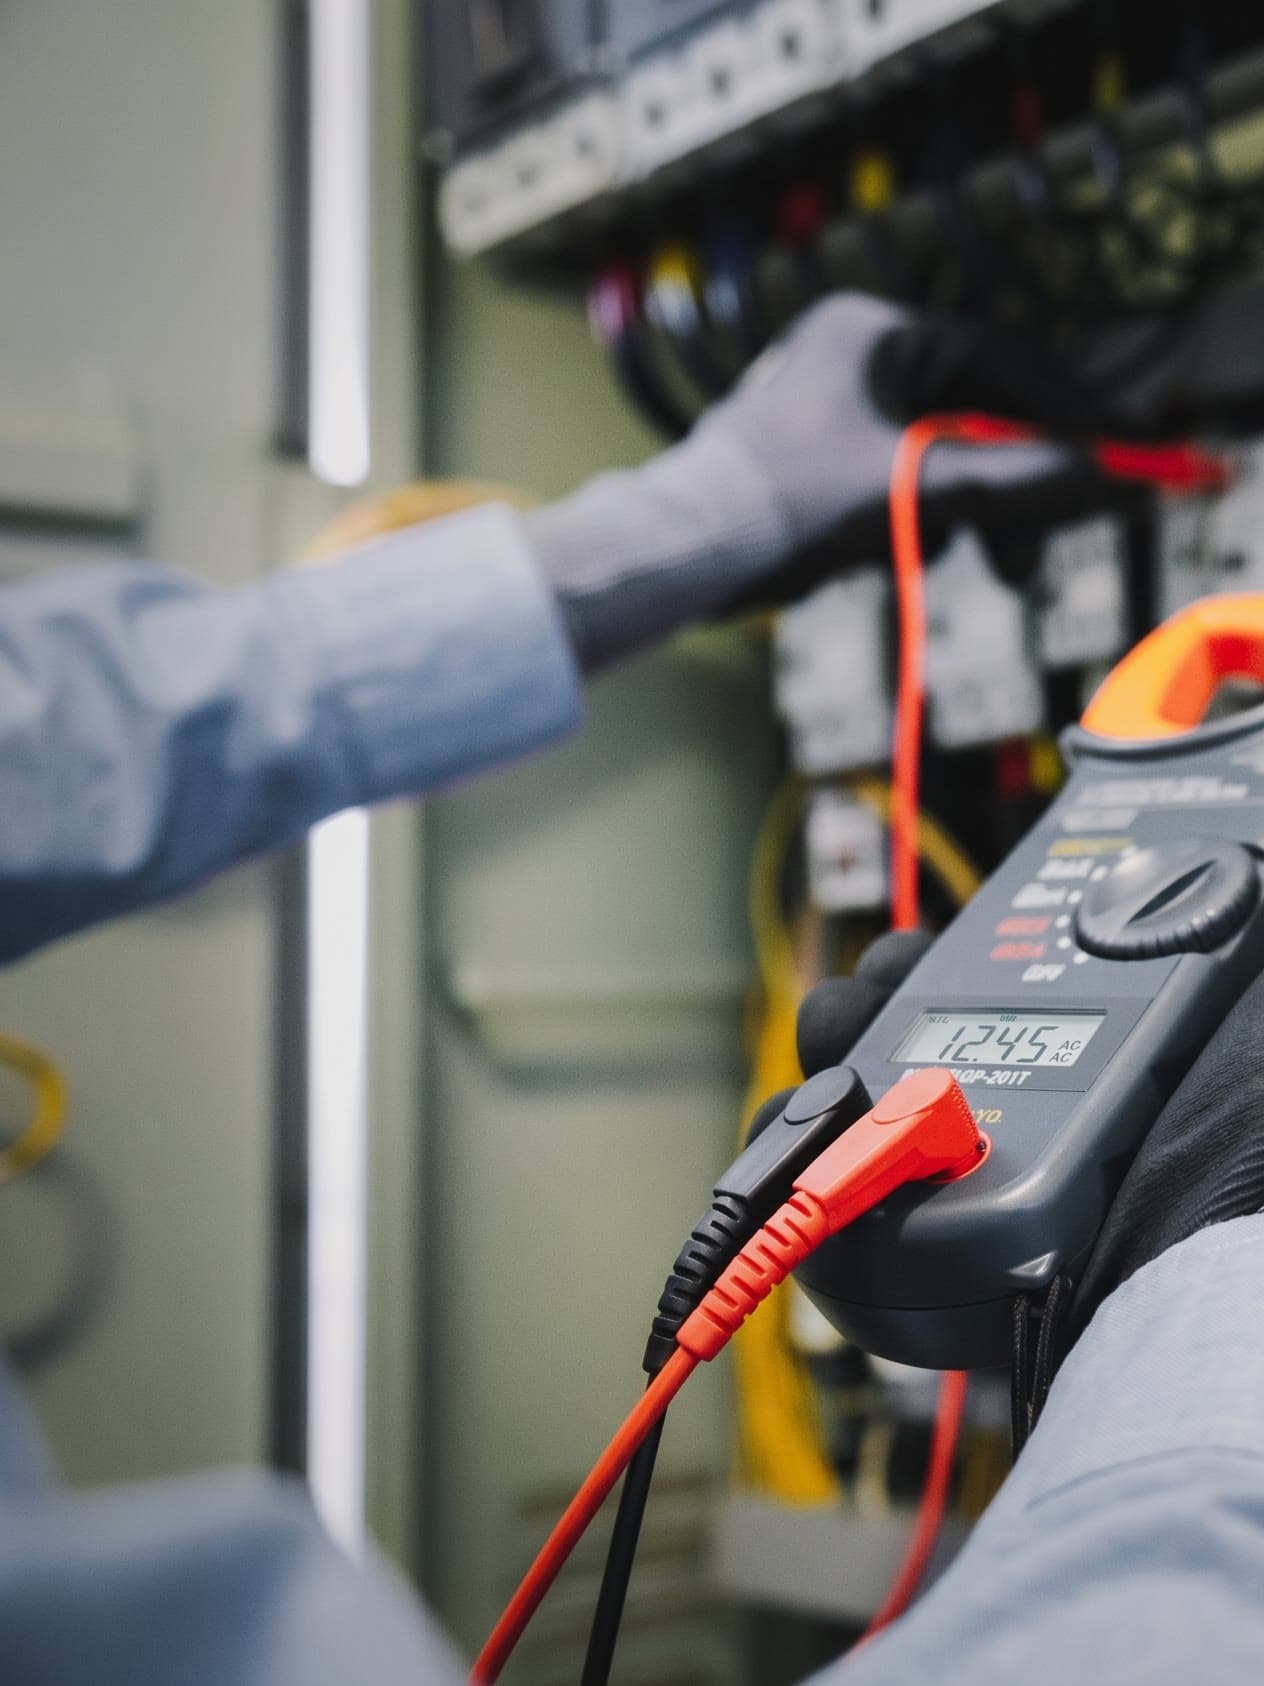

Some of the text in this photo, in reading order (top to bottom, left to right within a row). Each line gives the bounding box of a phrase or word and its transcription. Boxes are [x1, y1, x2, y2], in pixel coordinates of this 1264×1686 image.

[938, 1025, 1060, 1063] 12.45
[1058, 1040, 1081, 1053] AC
[1048, 1052, 1073, 1067] AC
[973, 1108, 1001, 1122] YO
